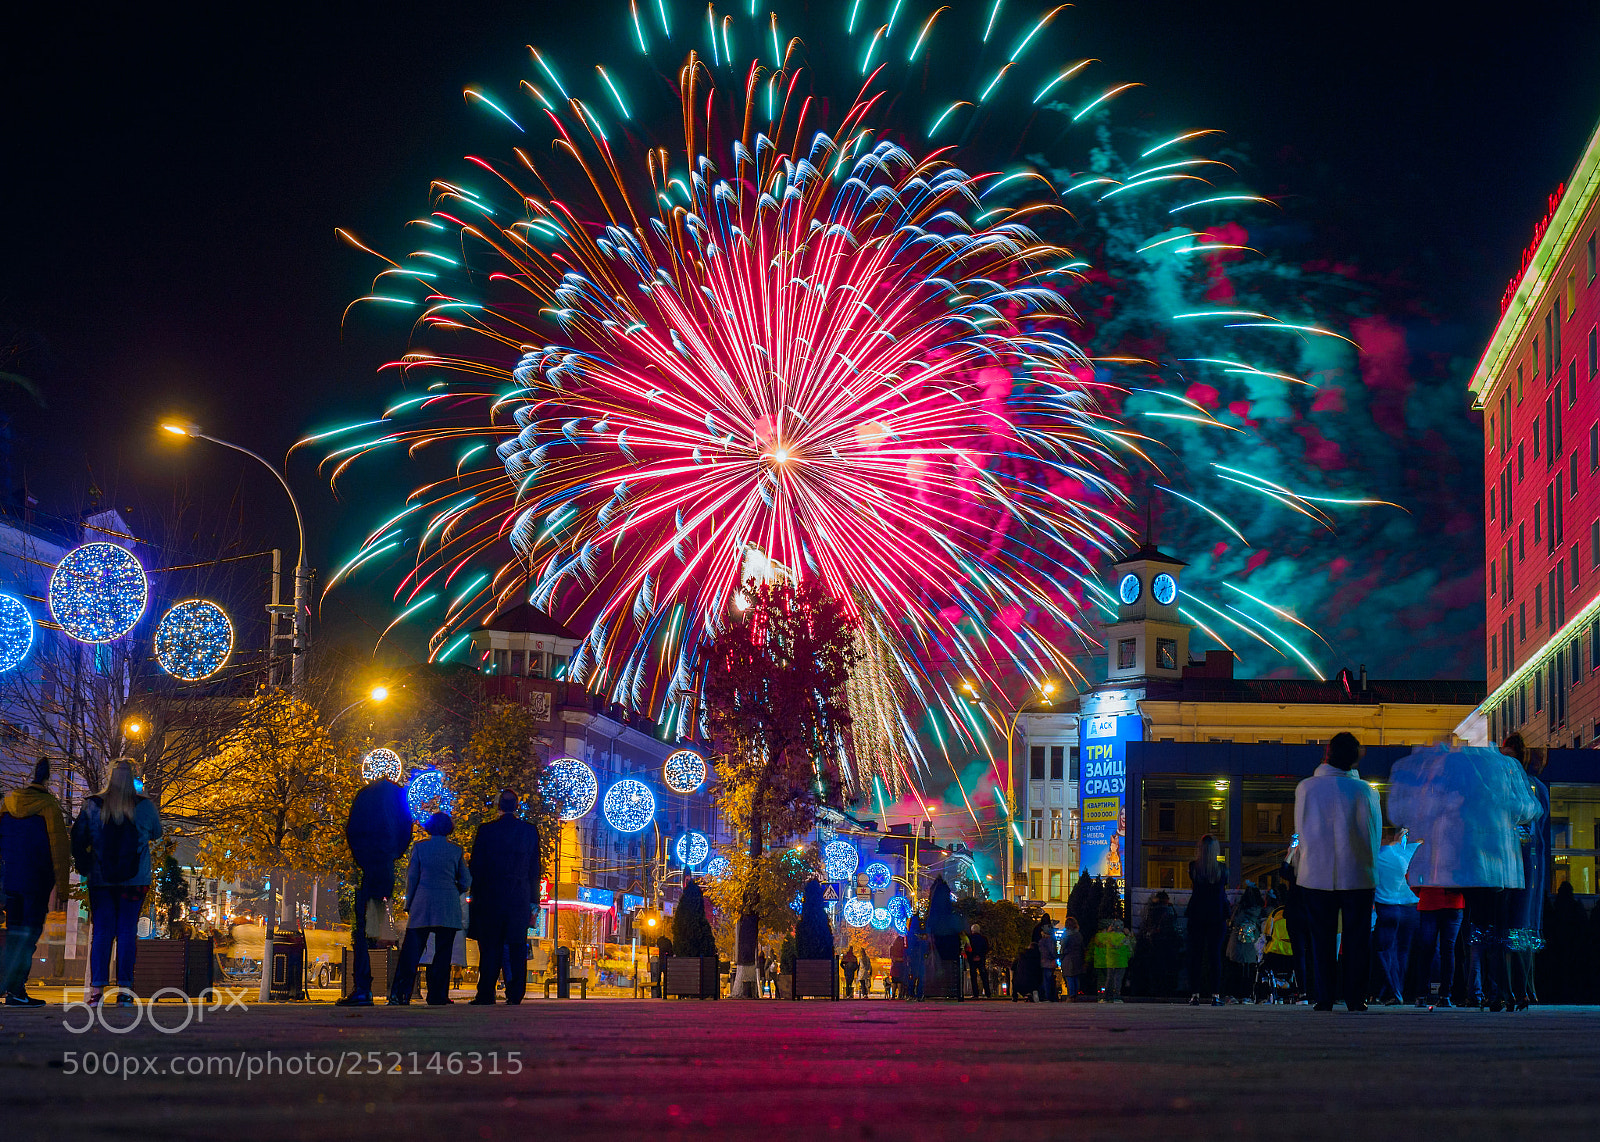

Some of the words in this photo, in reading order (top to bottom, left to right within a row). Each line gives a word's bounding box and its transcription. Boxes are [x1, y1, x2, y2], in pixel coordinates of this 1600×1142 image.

[1100, 721, 1113, 730] АСК
[1086, 744, 1113, 760] ТРИ
[1085, 759, 1126, 778] ЗАЙЦ
[1085, 778, 1126, 795] СРАЗУ
